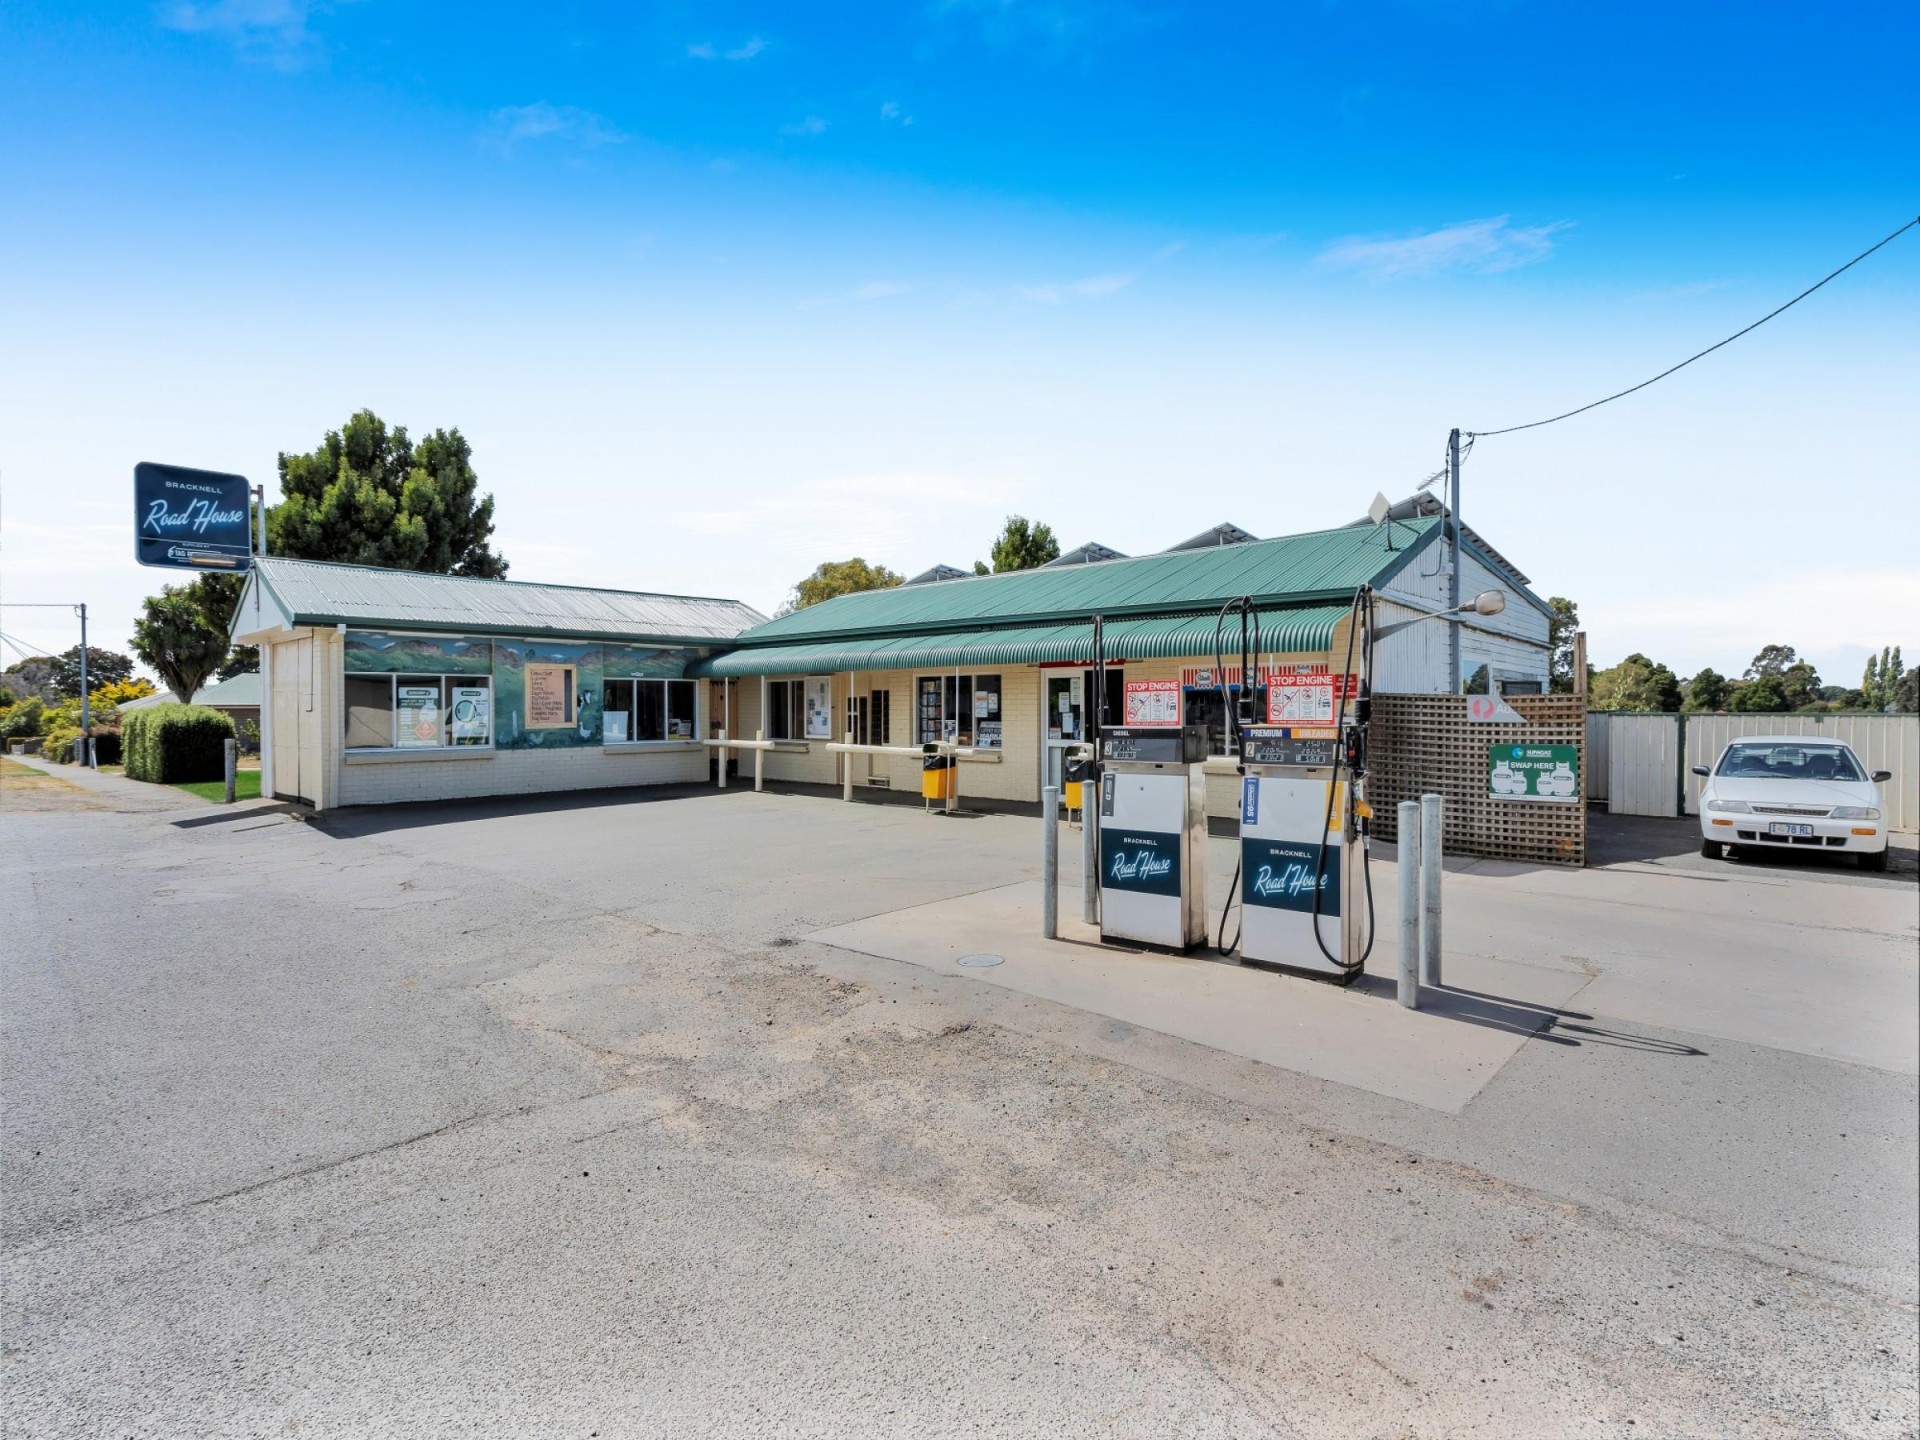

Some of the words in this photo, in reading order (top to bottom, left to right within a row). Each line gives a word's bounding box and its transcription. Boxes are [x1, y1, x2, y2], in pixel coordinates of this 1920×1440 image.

[164, 481, 223, 494] BRACKNELL
[143, 498, 197, 534] Road
[193, 500, 244, 534] House
[1127, 682, 1148, 691] STOP
[1149, 681, 1179, 690] ENGINE
[1270, 676, 1295, 686] STOP
[1296, 675, 1334, 685] ENGINE
[1250, 729, 1283, 738] PREMIUM
[1300, 729, 1335, 738] UNLEADED
[1105, 742, 1111, 755] 3
[1246, 743, 1253, 756] 2
[1510, 761, 1533, 769] SWAP
[1533, 762, 1555, 770] HERE
[1786, 825, 1797, 834] 78
[1799, 826, 1811, 835] RL
[1123, 837, 1158, 846] BRACKNELL
[1269, 848, 1313, 858] BRACKNELL
[1111, 850, 1142, 880] Road
[1139, 851, 1170, 880] House
[1254, 863, 1293, 897] Road
[1289, 864, 1329, 897] Houe
